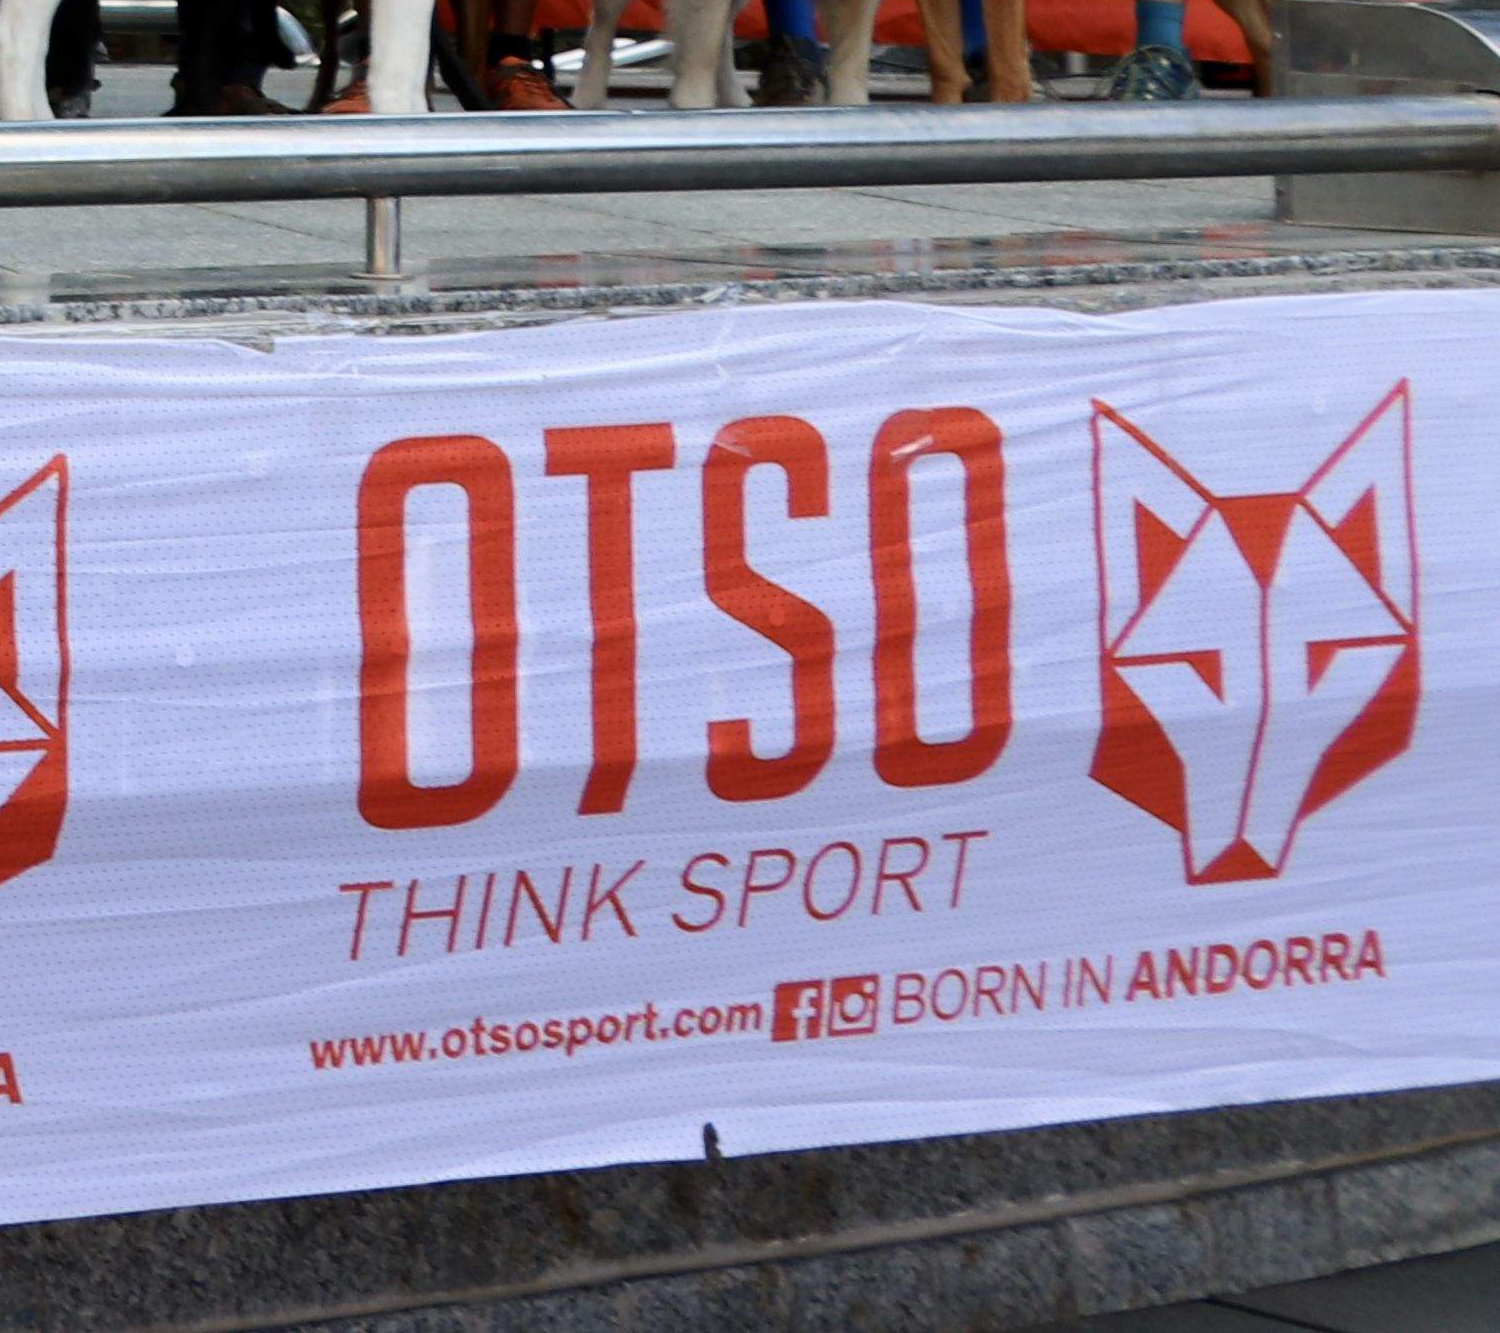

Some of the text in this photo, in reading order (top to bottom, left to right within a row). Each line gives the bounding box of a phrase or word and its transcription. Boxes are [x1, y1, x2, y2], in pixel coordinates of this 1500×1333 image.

[355, 405, 1014, 831] OTSO
[338, 829, 991, 962] THINK SPORT
[309, 928, 1387, 1070] www.otsosport.com BORN IN ANDORRA
